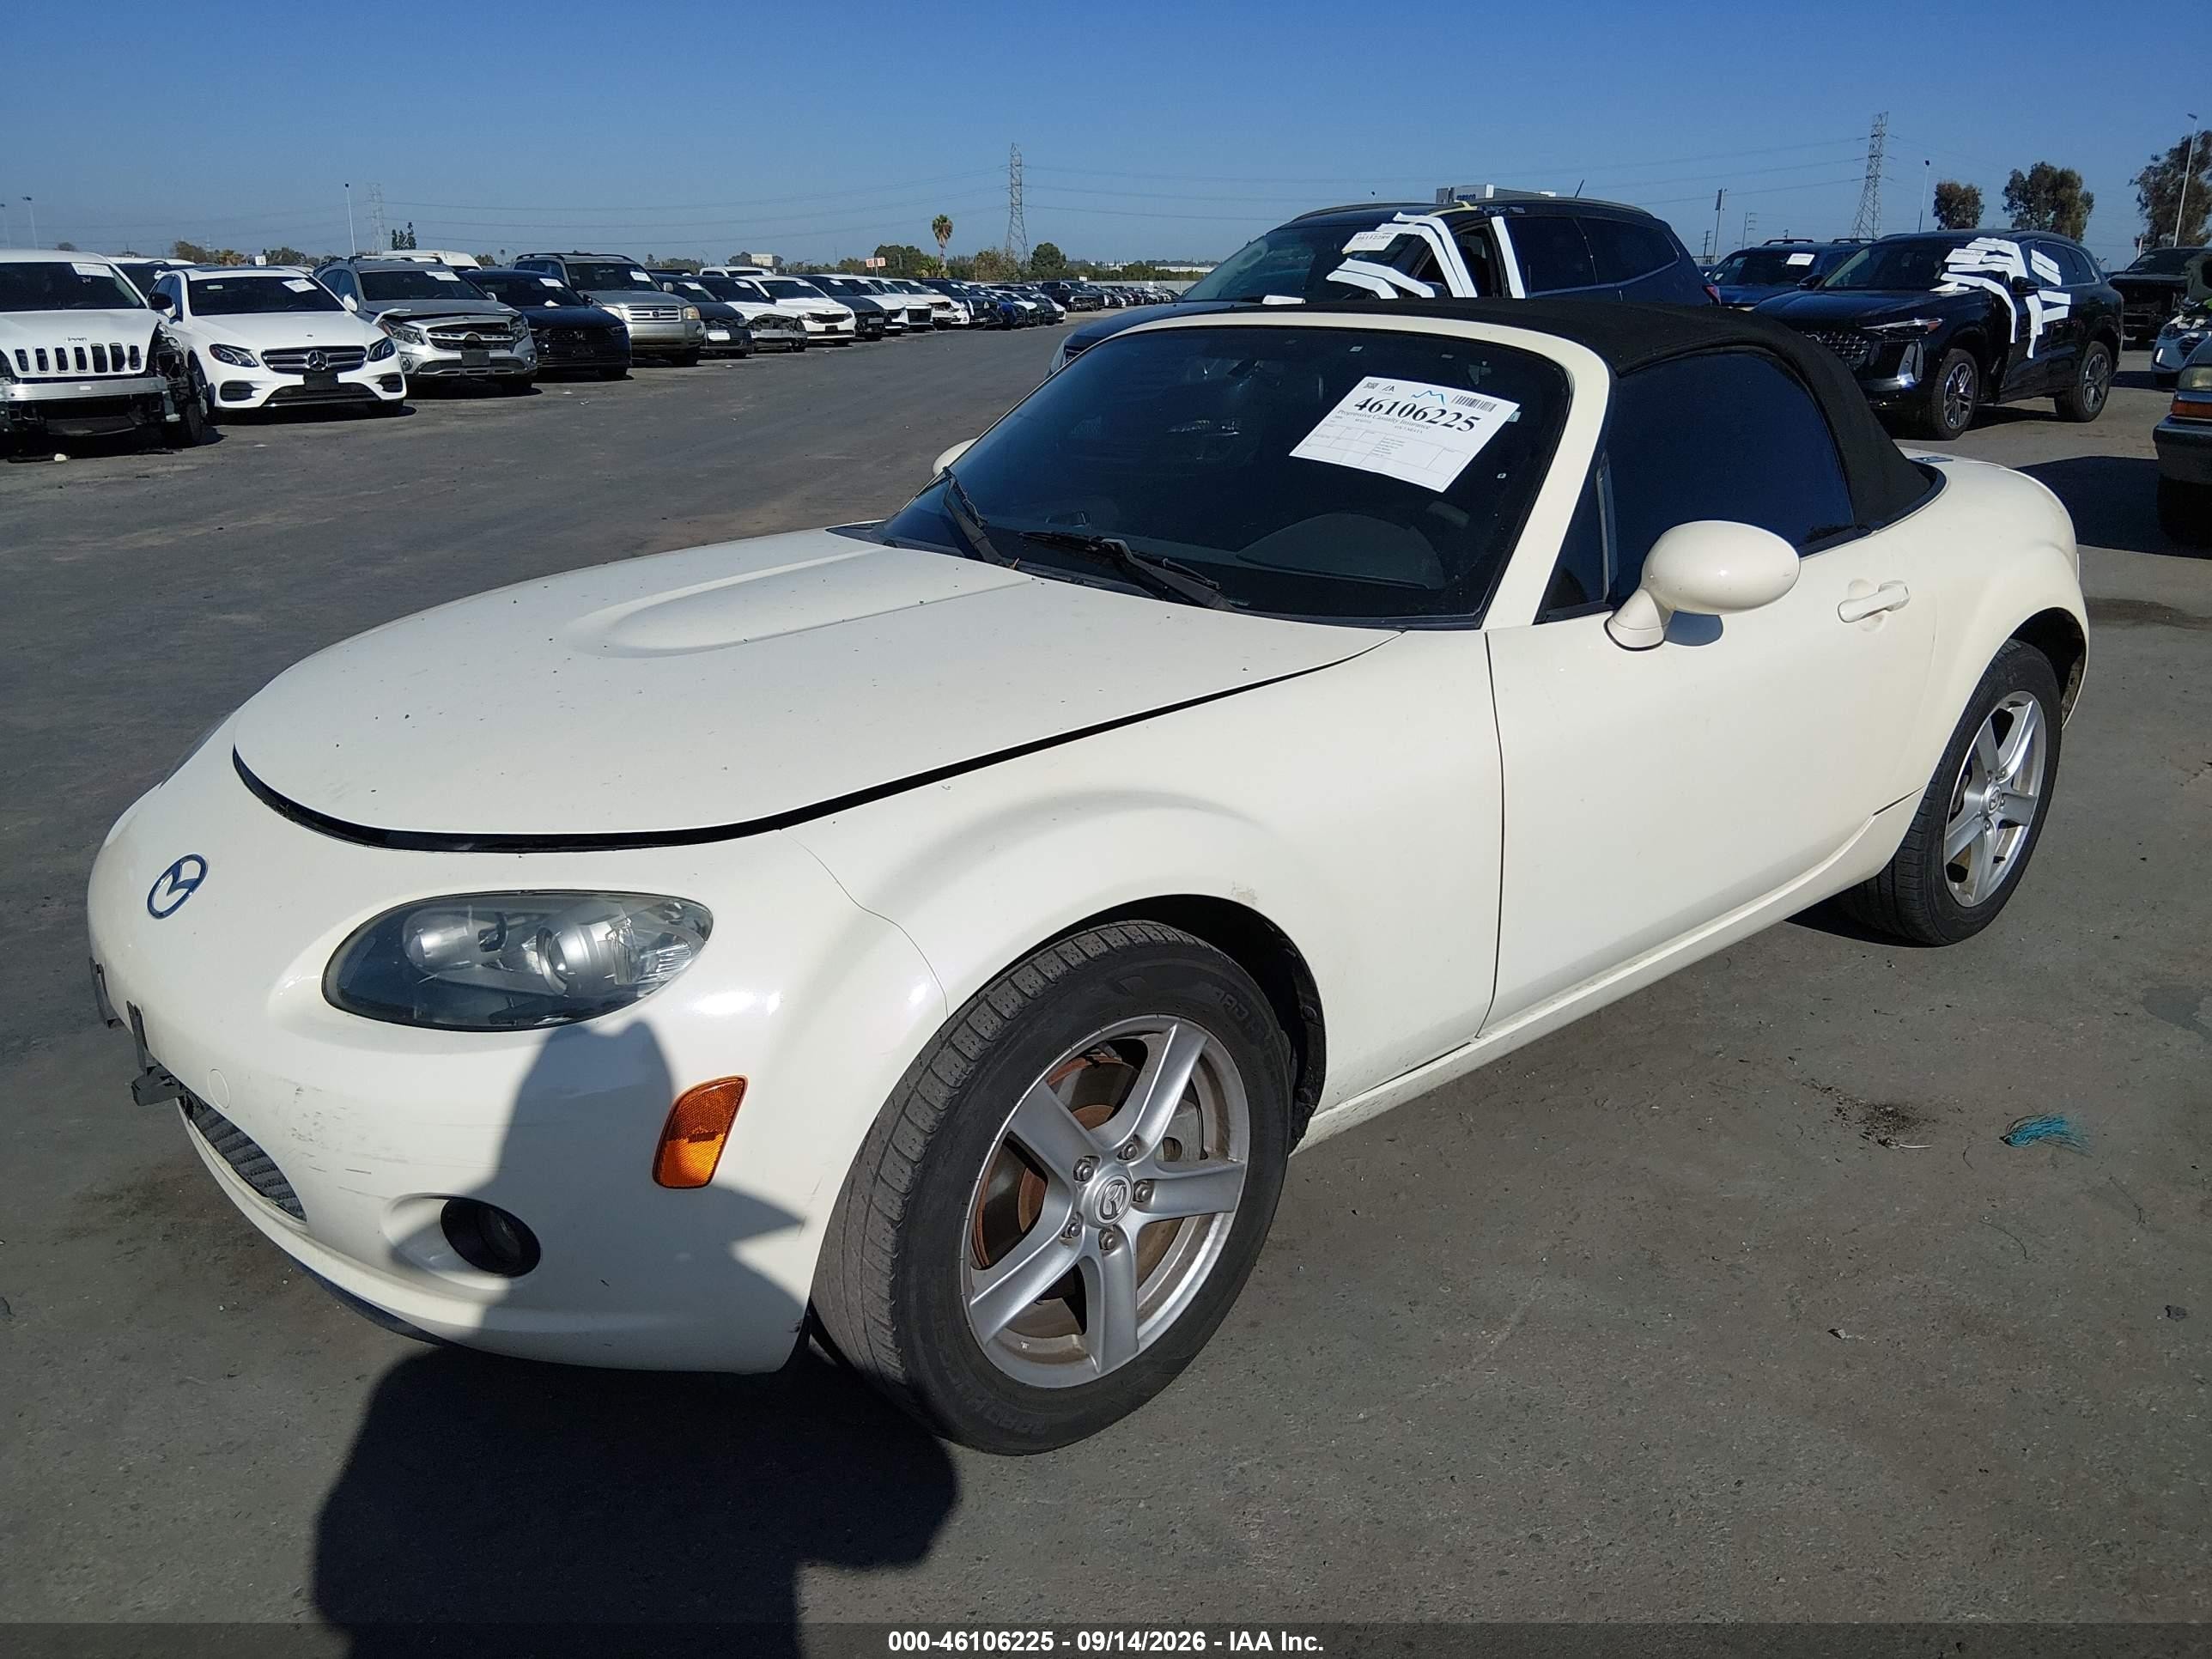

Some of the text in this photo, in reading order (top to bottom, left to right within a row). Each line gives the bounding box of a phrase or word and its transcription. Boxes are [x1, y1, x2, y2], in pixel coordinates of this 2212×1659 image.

[1354, 396, 1482, 432] 46106225
[1373, 414, 1399, 424] Casualty
[1400, 418, 1431, 430] Insurance
